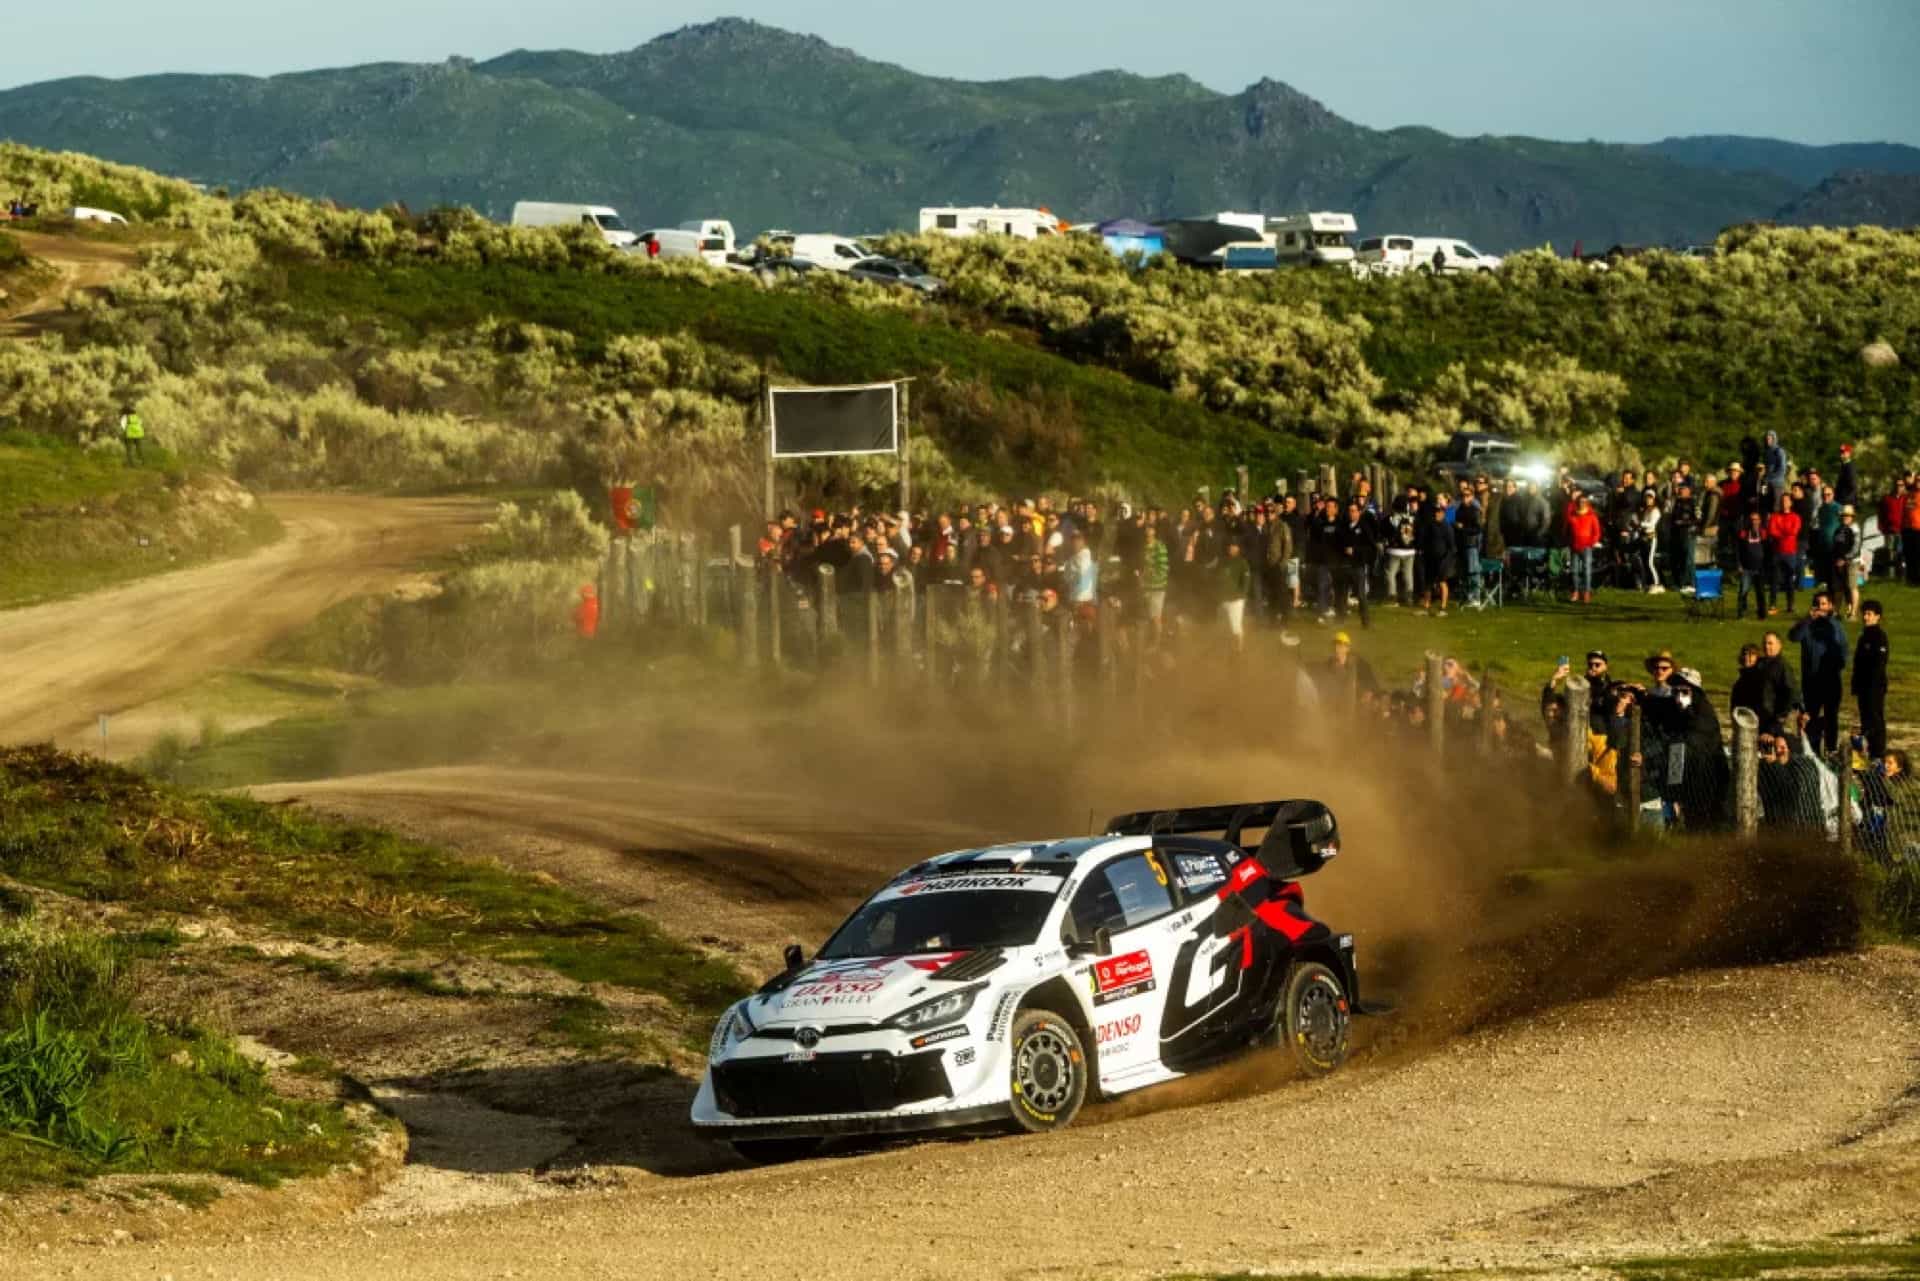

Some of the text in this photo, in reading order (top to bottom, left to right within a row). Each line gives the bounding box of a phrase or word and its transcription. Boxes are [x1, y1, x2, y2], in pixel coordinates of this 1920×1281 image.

[1144, 849, 1168, 886] 5
[793, 981, 884, 997] DENSO
[1096, 1013, 1141, 1044] DENSO
